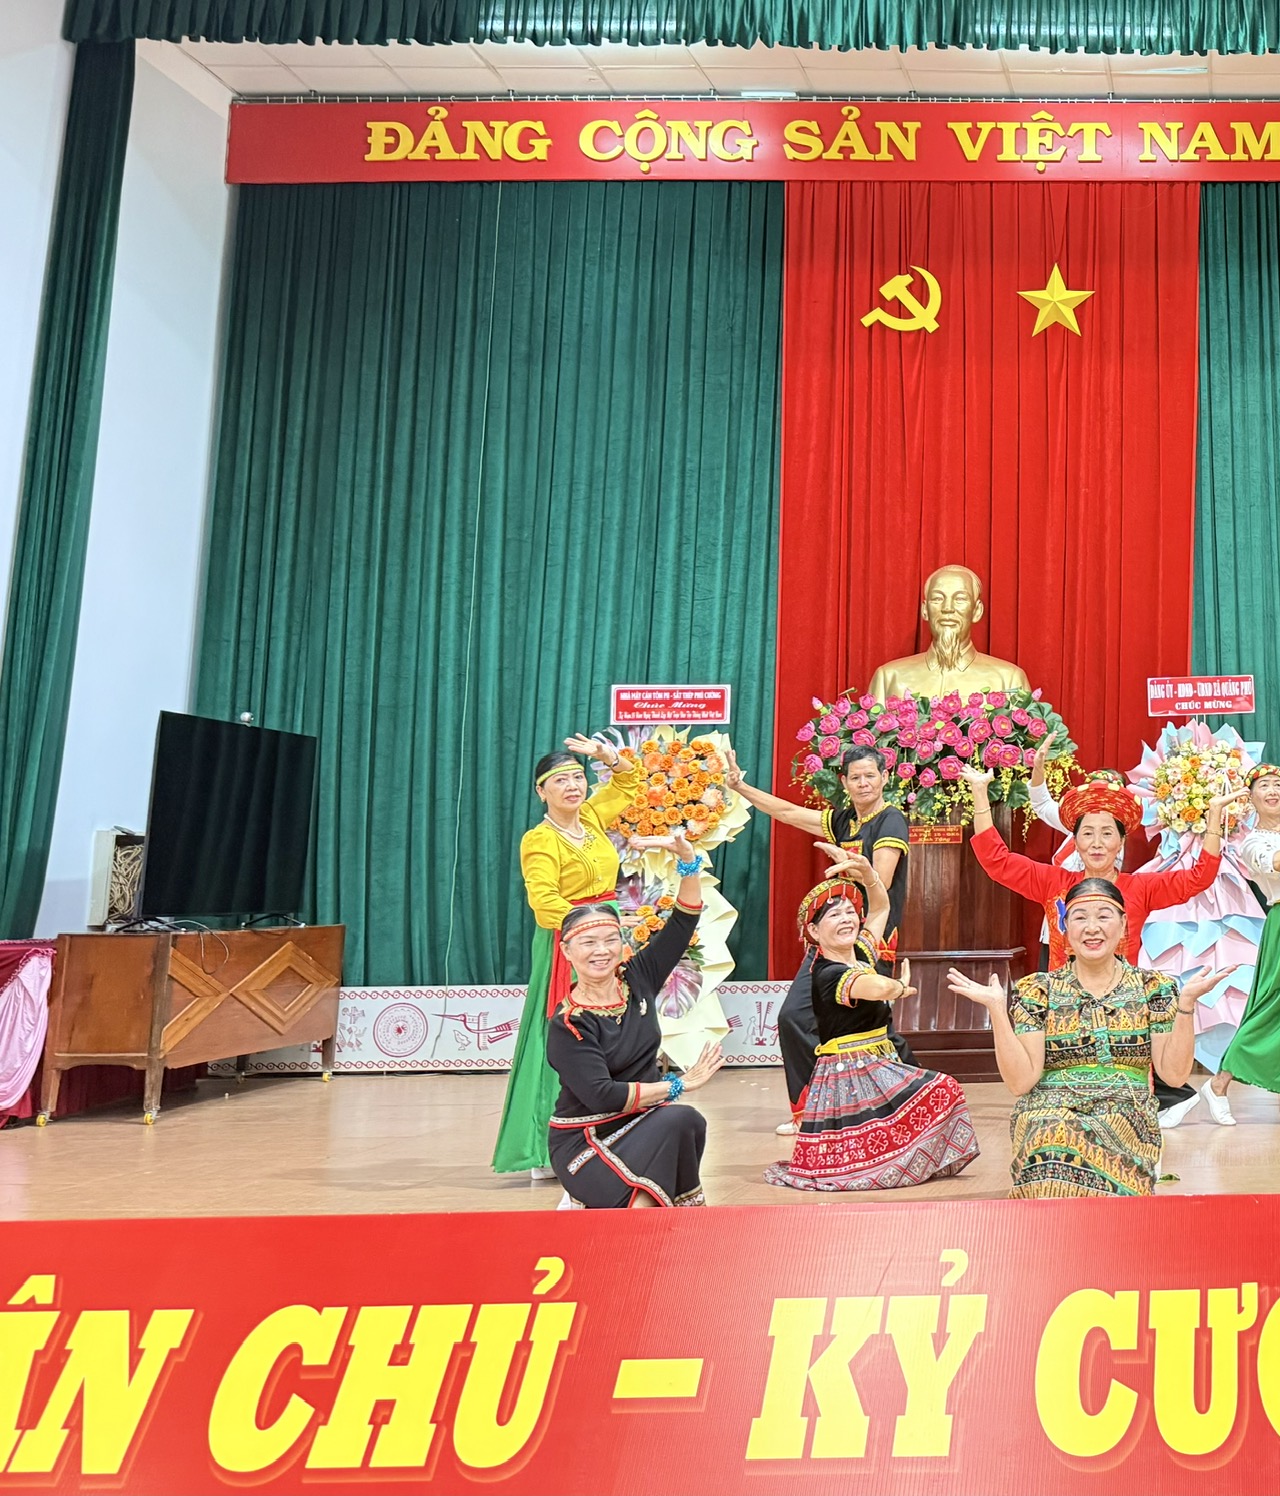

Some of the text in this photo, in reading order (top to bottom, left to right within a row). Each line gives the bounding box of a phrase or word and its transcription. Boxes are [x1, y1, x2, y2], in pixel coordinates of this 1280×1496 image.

[365, 106, 552, 161] ĐẢNG
[579, 108, 758, 171] CỘNG
[783, 106, 921, 160] SẢN
[948, 110, 1112, 171] VIỆT
[1175, 700, 1232, 710] CHÚC MỪNG
[209, 1257, 576, 1471] CHỦ
[746, 1249, 988, 1459] KỶ
